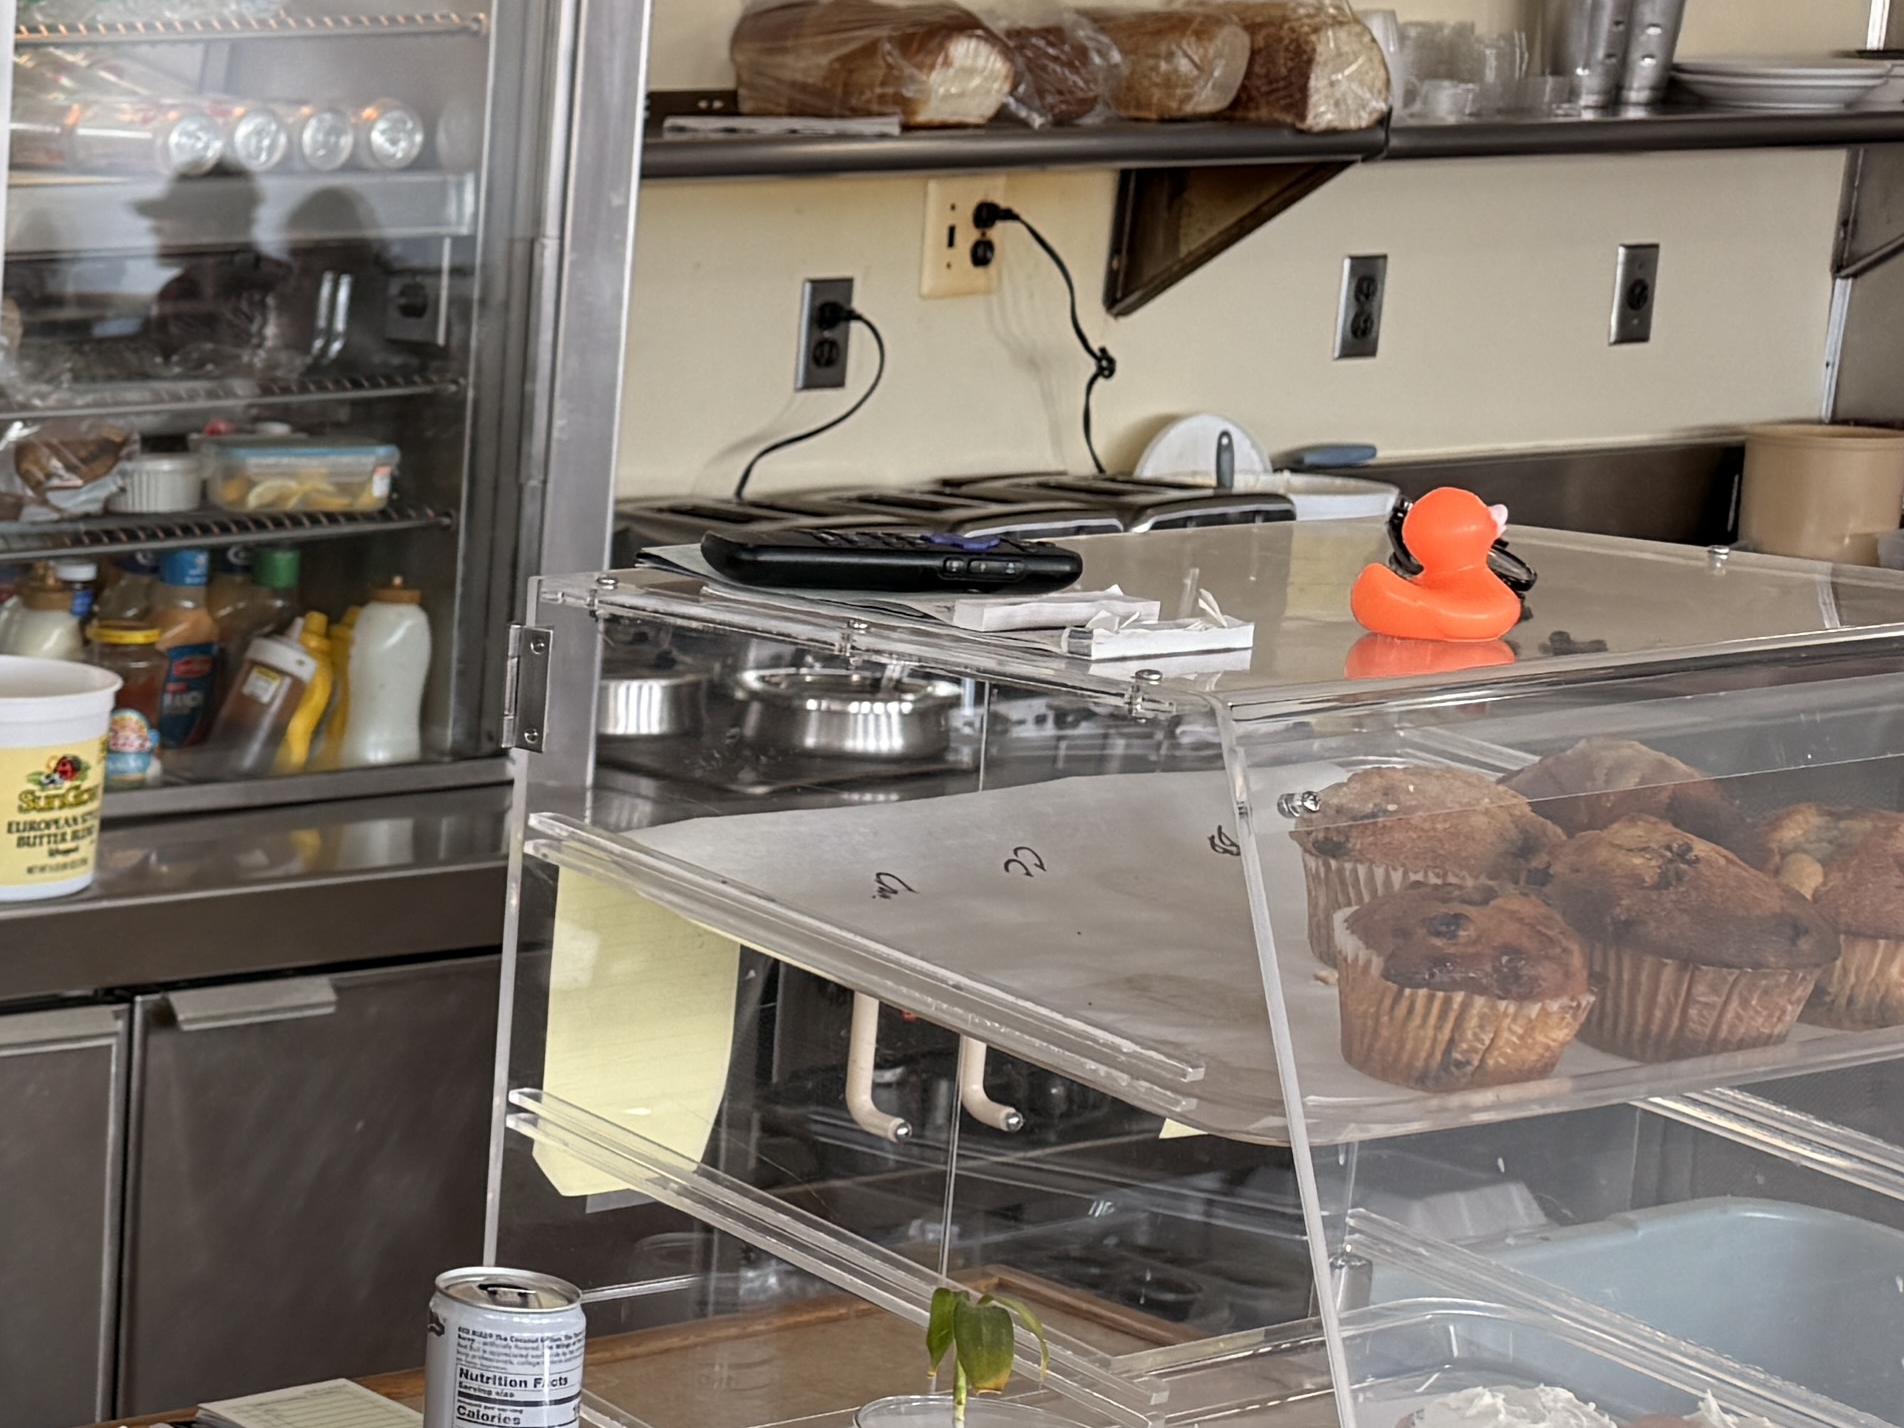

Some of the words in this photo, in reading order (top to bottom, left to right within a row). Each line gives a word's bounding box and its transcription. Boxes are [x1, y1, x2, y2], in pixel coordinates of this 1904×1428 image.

[6, 819, 79, 836] EUROPEAN
[16, 833, 69, 849] BUTTER
[458, 1367, 530, 1390] Nutrition
[456, 1404, 521, 1427] Calories
